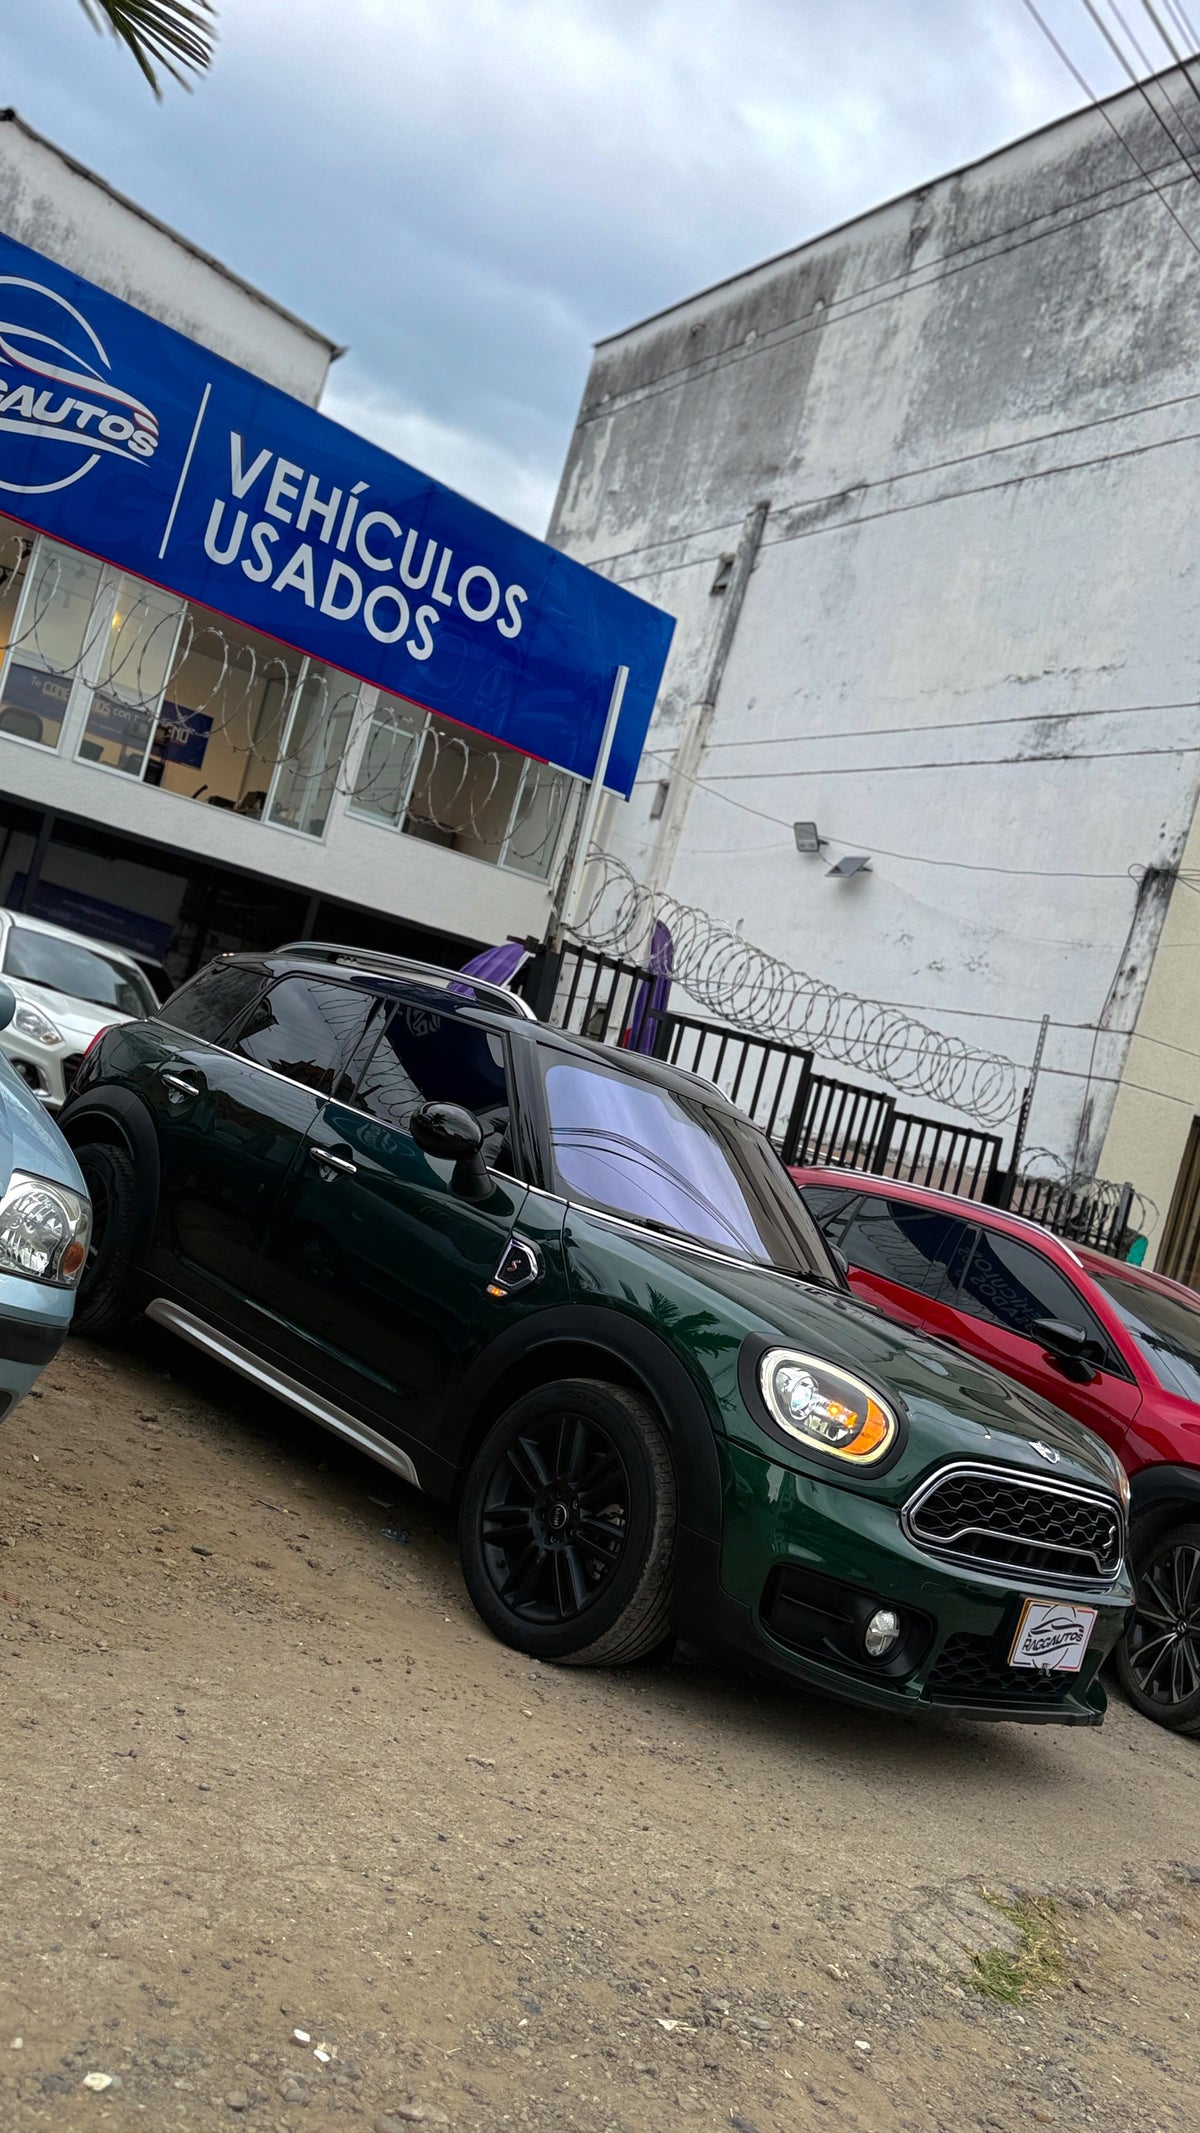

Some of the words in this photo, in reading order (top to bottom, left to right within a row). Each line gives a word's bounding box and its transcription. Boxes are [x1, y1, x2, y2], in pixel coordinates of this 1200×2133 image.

[203, 499, 440, 661] USADOS
[229, 431, 528, 639] VEHÍCULOS
[1022, 1632, 1083, 1652] RAGGAUTOS
